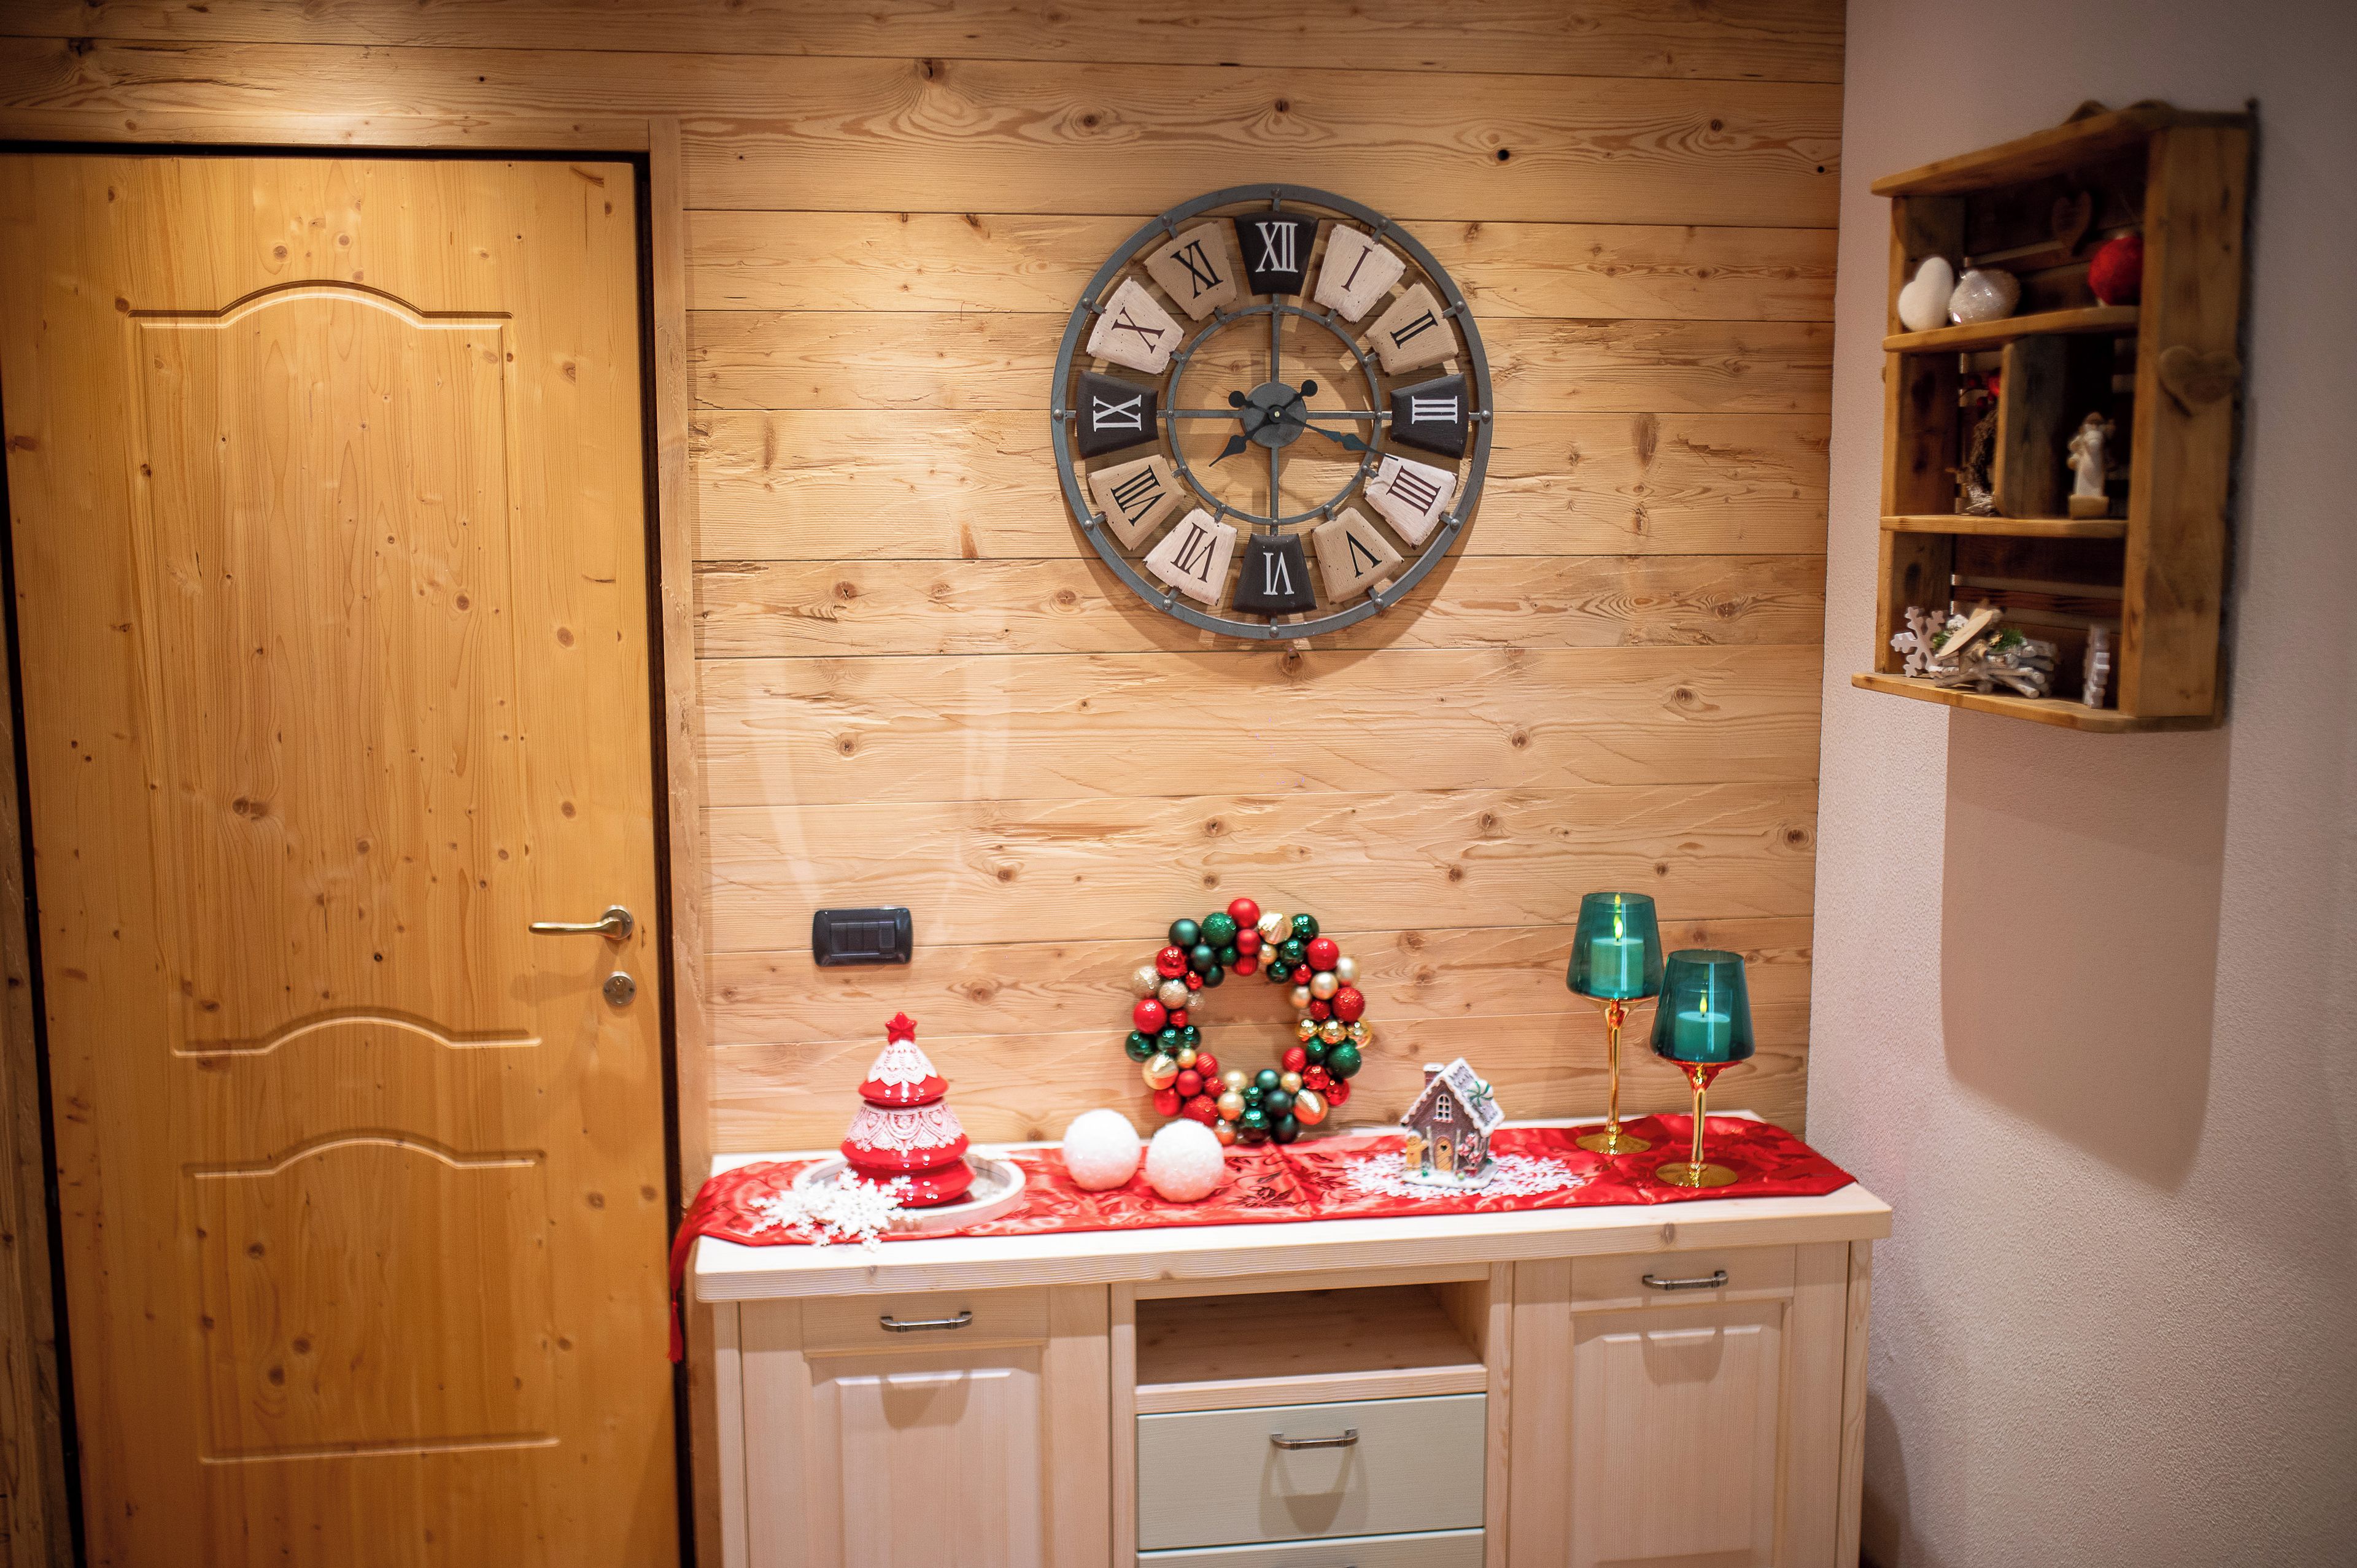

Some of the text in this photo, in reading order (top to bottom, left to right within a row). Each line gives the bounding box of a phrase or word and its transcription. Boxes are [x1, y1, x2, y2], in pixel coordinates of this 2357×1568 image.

[1171, 240, 1223, 299] XI
[1255, 222, 1299, 274] XII
[1342, 246, 1373, 292] I
[1112, 307, 1165, 353] X
[1390, 309, 1438, 349] II
[1093, 395, 1142, 431] IX
[1411, 395, 1458, 424] III
[1110, 465, 1166, 527] VIII
[1385, 465, 1441, 517] IIII
[1171, 522, 1220, 583] VII
[1263, 552, 1295, 595] VI
[1346, 531, 1382, 577] V
